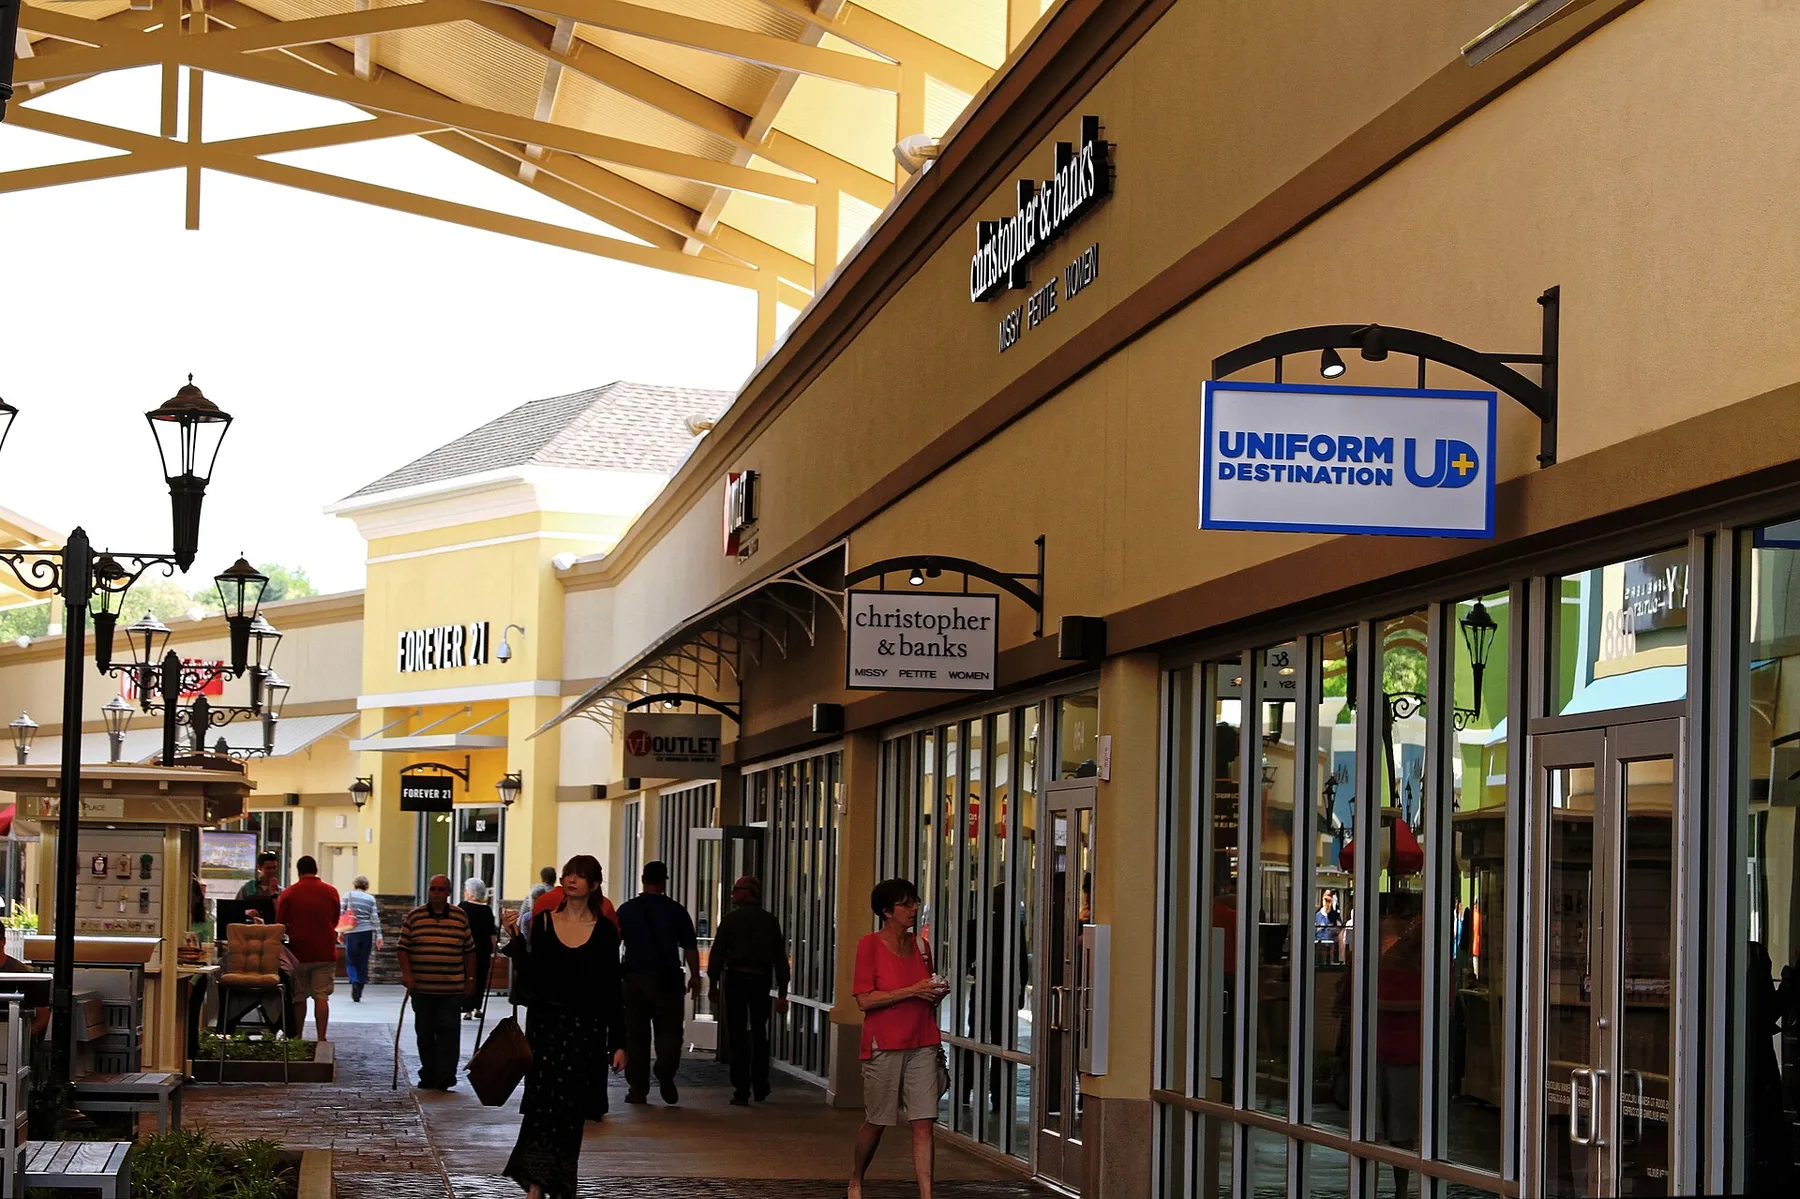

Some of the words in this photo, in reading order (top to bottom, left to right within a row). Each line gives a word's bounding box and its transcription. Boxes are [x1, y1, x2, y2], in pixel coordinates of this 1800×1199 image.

[970, 180, 1038, 302] christopher
[1039, 180, 1052, 240] &
[1052, 116, 1097, 230] banks
[998, 305, 1023, 353] MISSY
[1027, 277, 1058, 330] PETITE
[1064, 242, 1099, 300] WOMEN
[1218, 431, 1394, 464] UNIFORM
[1218, 462, 1393, 486] DESTINATION
[855, 604, 991, 635] christopher
[397, 625, 466, 673] FOREVER
[469, 621, 489, 666] 21
[877, 638, 896, 656] &
[899, 633, 967, 658] banks
[855, 668, 888, 677] MISSY
[899, 669, 937, 679] PETITE
[948, 671, 990, 680] WOMEN
[652, 736, 721, 754] OUTLET
[403, 788, 440, 799] FOREVER
[441, 789, 452, 799] 21
